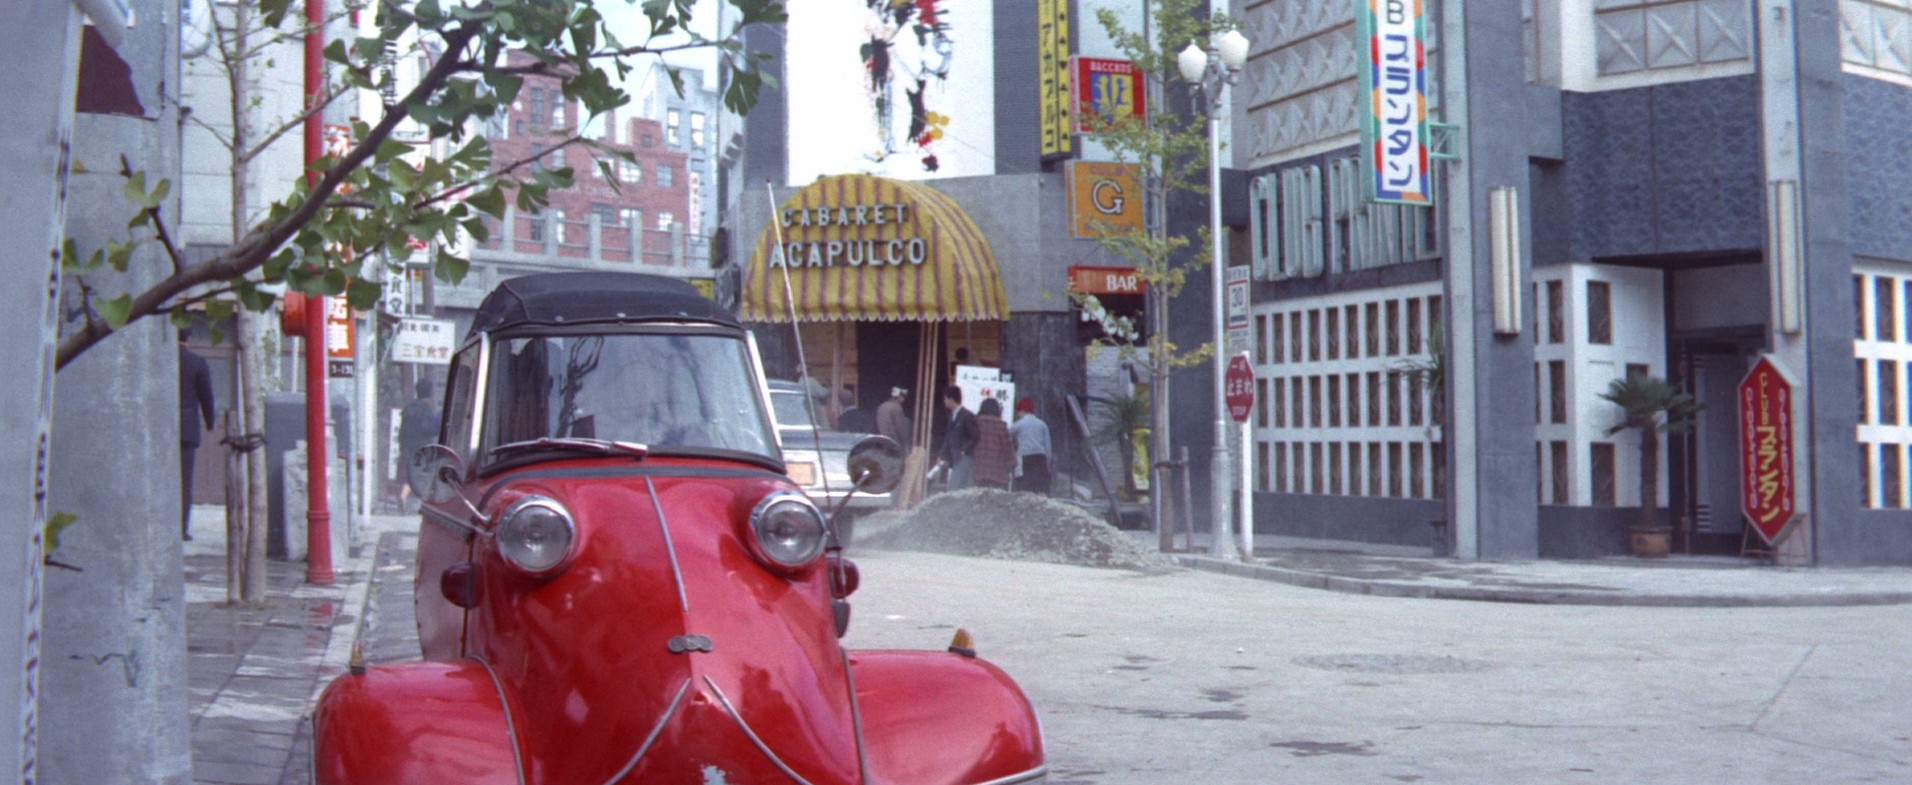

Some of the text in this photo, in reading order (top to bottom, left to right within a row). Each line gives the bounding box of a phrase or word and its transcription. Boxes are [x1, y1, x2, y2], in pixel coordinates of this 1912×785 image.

[1092, 179, 1124, 216] G
[781, 203, 908, 228] CABARET
[1250, 164, 1325, 282] CLUB
[769, 238, 927, 269] ACAPULCO
[1106, 274, 1138, 291] BAR
[1231, 286, 1244, 307] 30
[1226, 377, 1253, 397] 止まれ
[1758, 372, 1770, 424] CLUB
